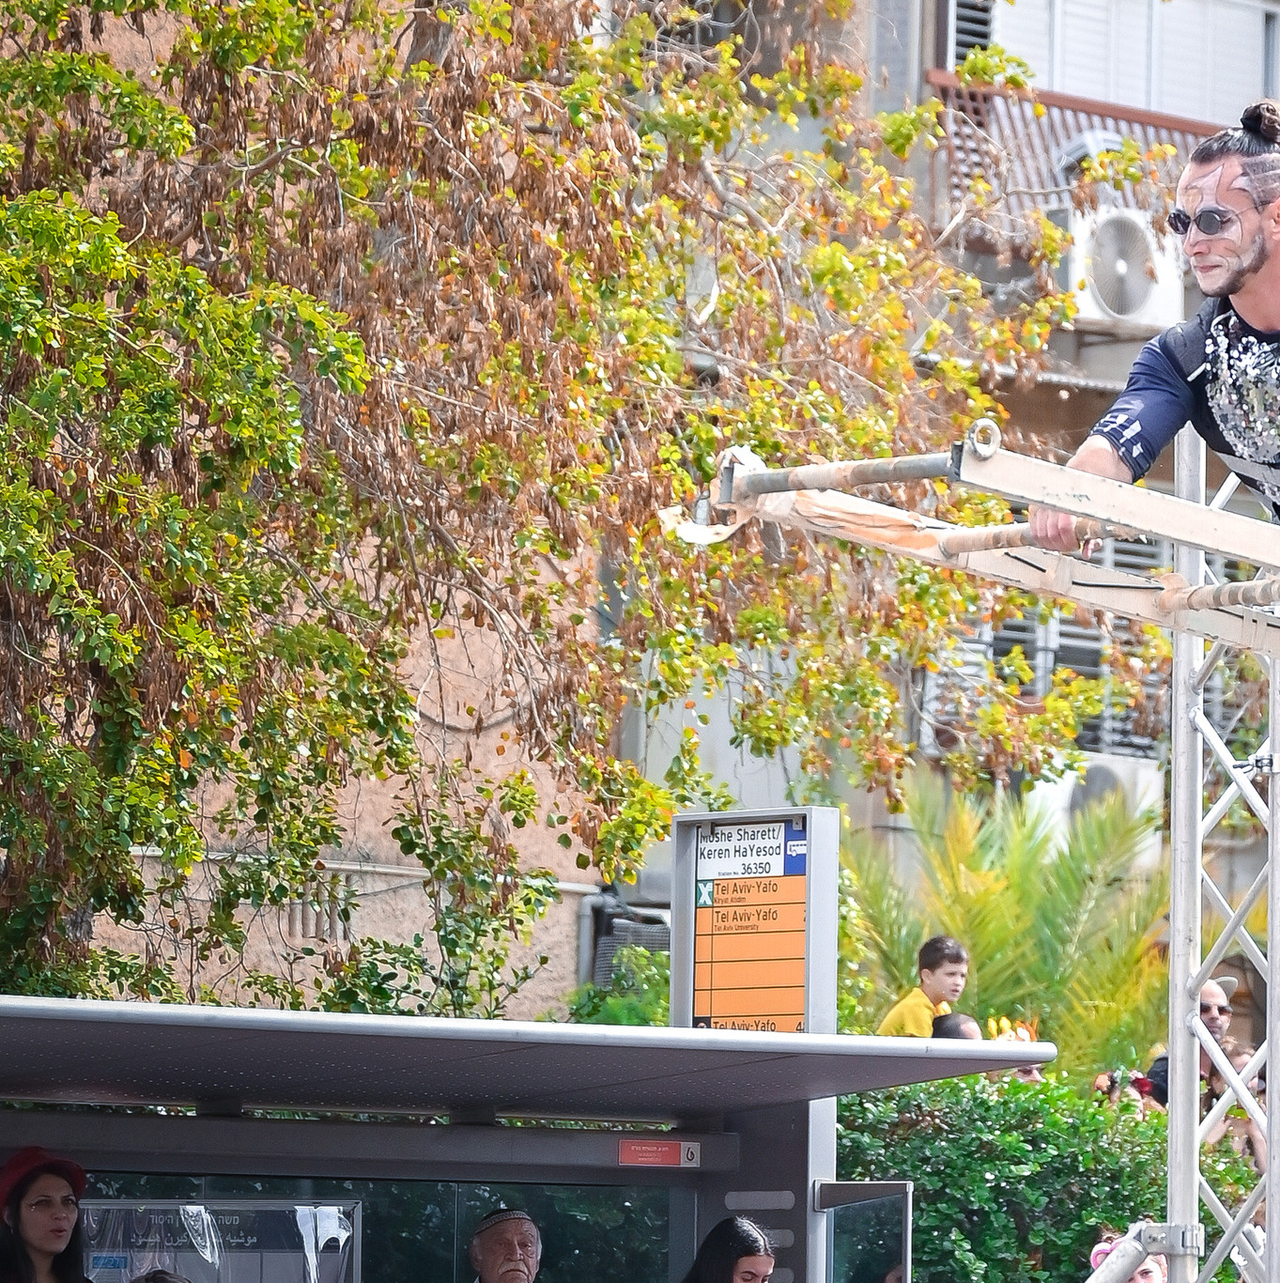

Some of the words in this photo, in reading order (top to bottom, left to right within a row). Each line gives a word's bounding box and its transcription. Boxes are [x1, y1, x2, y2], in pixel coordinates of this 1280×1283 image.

[736, 825, 781, 841] Sharett/
[699, 847, 730, 859] Keren
[733, 843, 781, 858] HaYesod
[741, 862, 771, 875] 36350
[714, 882, 729, 895] Tel
[732, 880, 778, 895] Aviv-Yafo
[714, 910, 729, 923] Tel
[732, 908, 778, 922] Aviv-Yafo
[219, 1214, 240, 1225] משה
